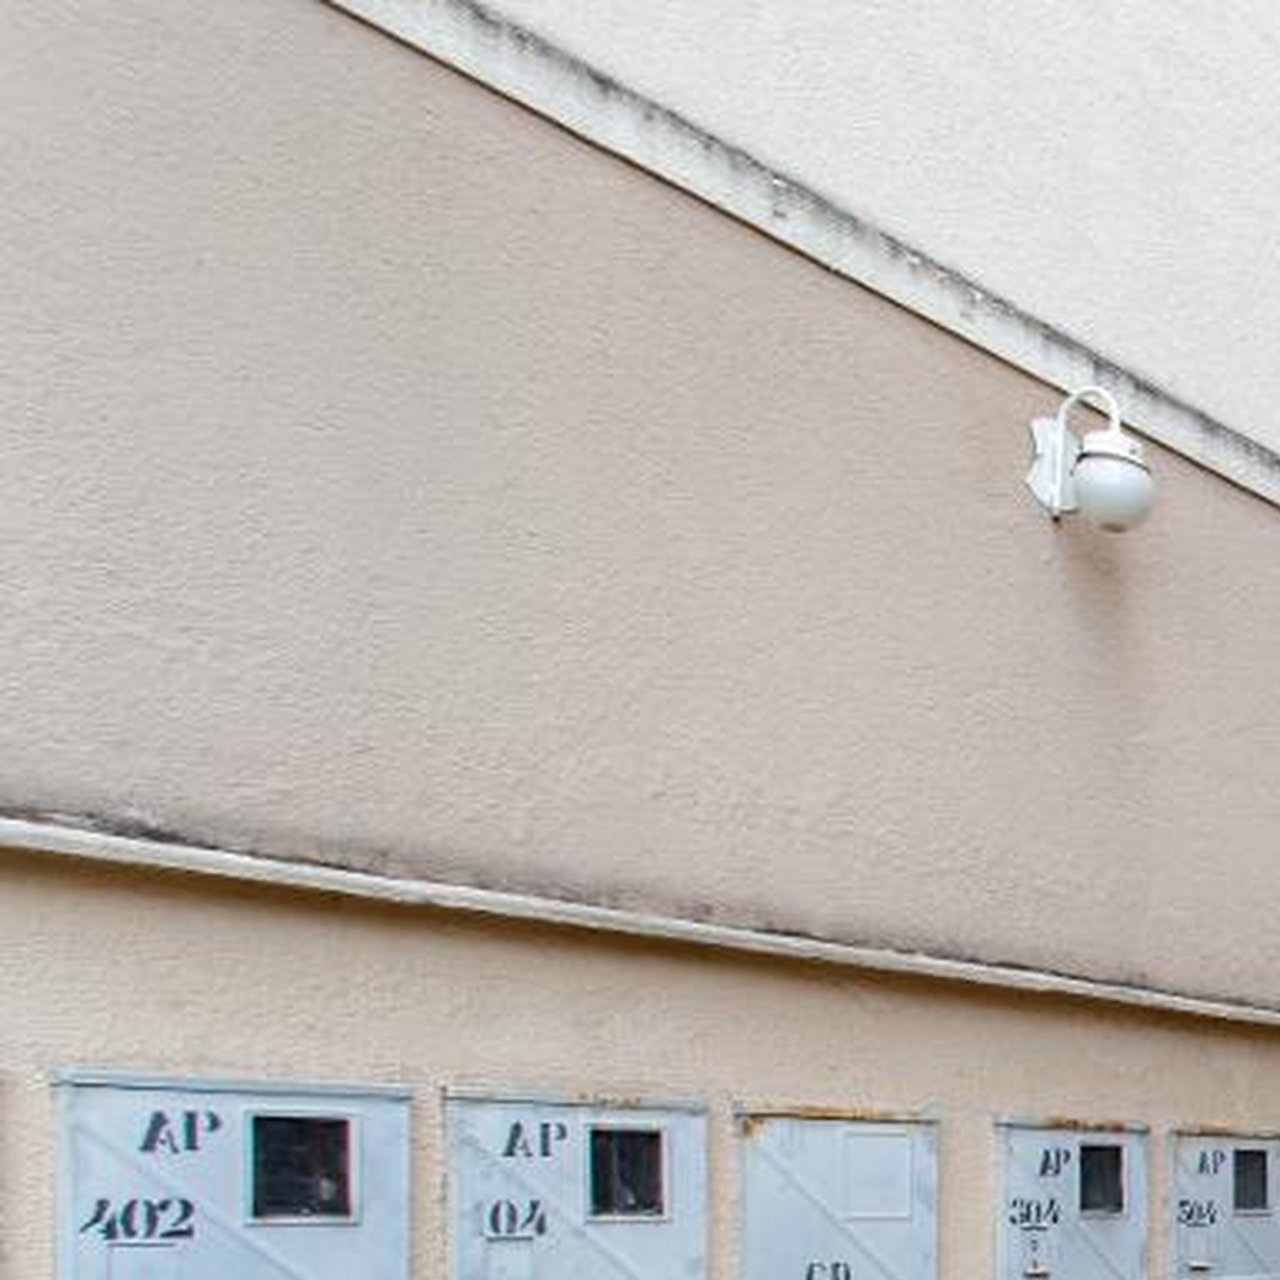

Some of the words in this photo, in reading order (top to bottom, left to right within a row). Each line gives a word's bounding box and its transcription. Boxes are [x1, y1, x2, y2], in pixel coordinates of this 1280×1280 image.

[140, 1110, 221, 1153] AP
[502, 1121, 568, 1158] AP
[1040, 1149, 1071, 1176] AP
[80, 1198, 194, 1240] 402
